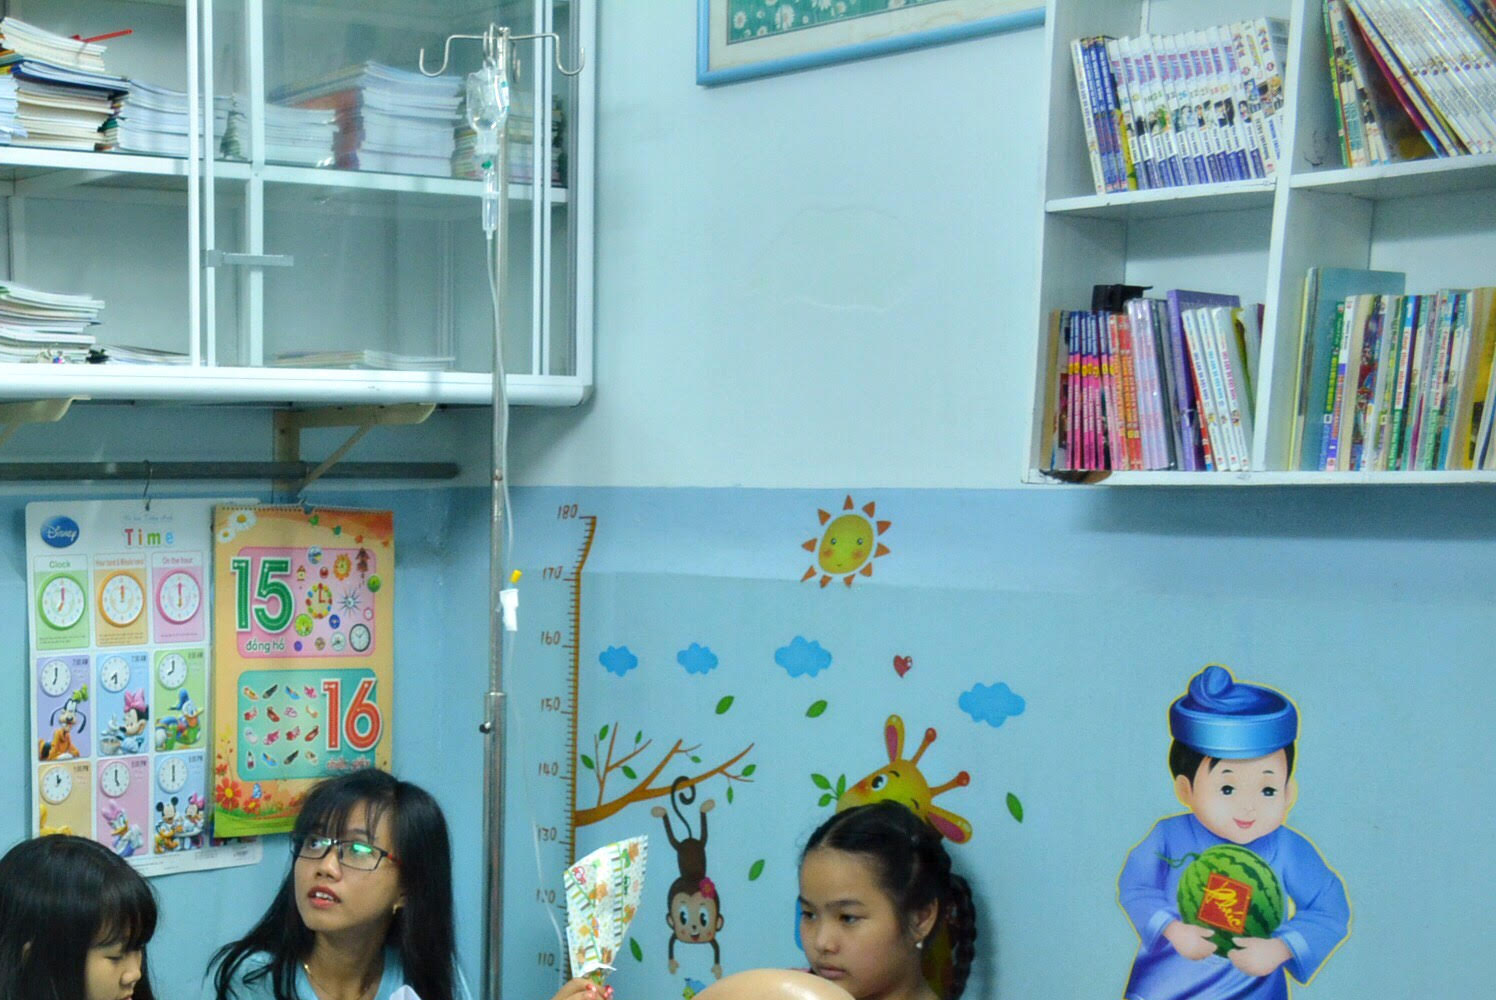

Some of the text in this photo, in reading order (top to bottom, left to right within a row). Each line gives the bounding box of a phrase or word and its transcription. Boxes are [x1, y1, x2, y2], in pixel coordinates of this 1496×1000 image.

[557, 503, 579, 520] 180
[47, 526, 77, 543] Disney
[124, 527, 174, 547] Time
[49, 560, 71, 569] Clock
[543, 565, 564, 580] 170
[231, 556, 295, 633] 15
[540, 630, 561, 645] 160
[540, 697, 561, 712] 150
[321, 677, 382, 751] 16
[538, 762, 559, 776] 140
[537, 827, 558, 842] 130
[538, 952, 554, 967] 110
